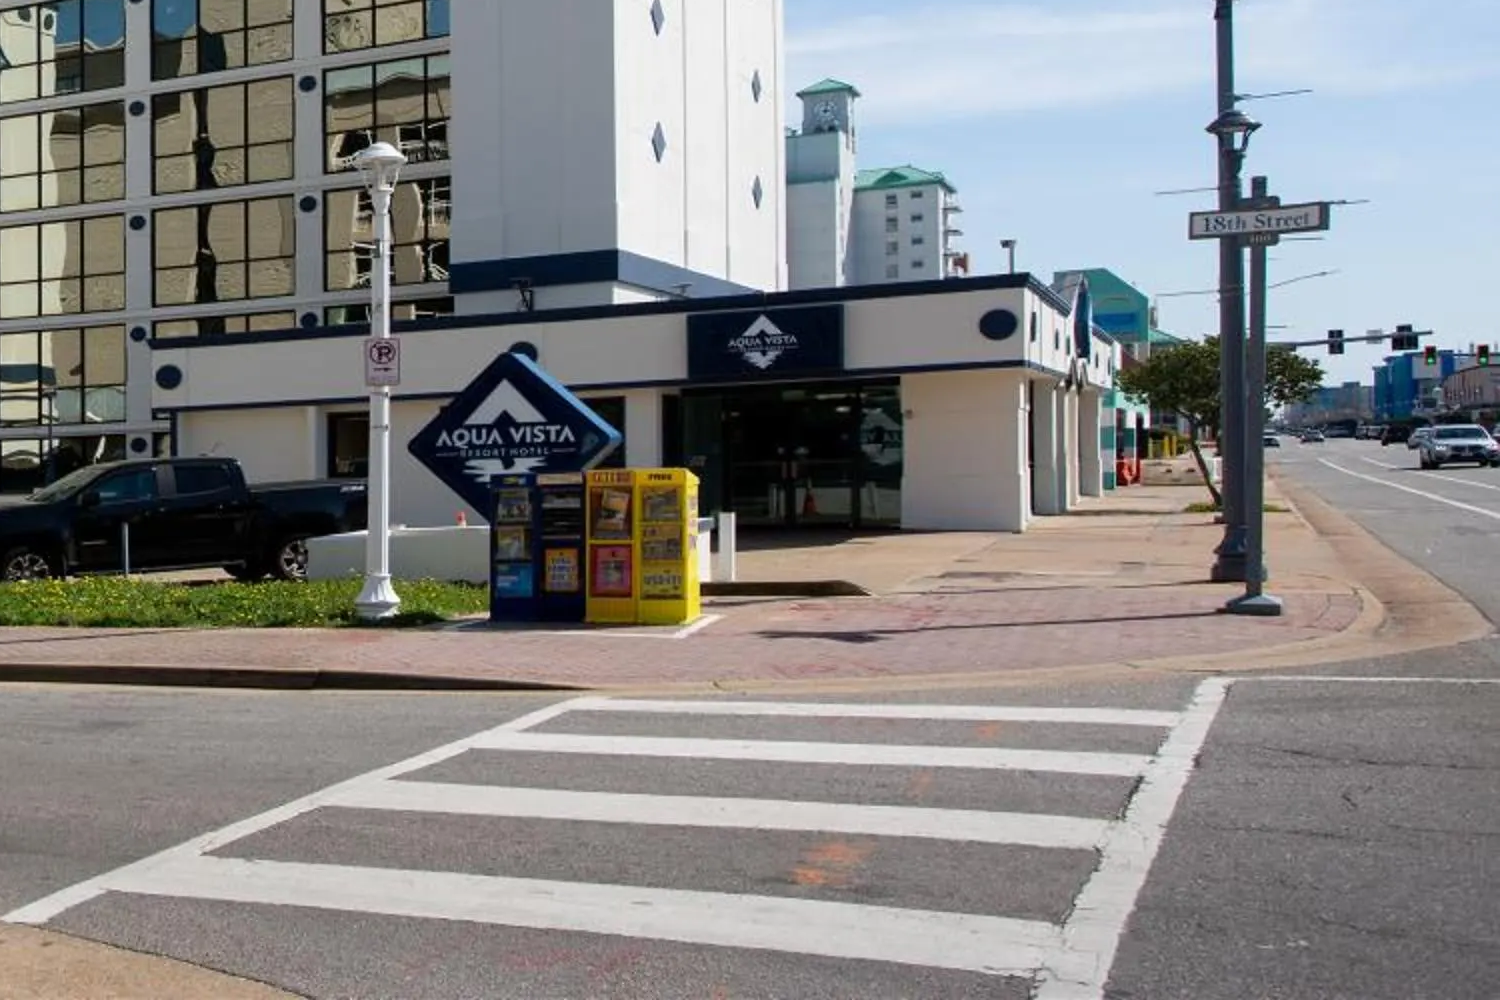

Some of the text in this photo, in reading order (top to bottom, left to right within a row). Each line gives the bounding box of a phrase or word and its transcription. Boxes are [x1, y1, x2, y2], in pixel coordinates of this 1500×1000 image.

[1203, 213, 1310, 232] 18th Street
[728, 334, 797, 347] AQUA VISTA
[435, 424, 576, 449] AQUA VISTA
[459, 446, 550, 458] RESORT HOTEL
